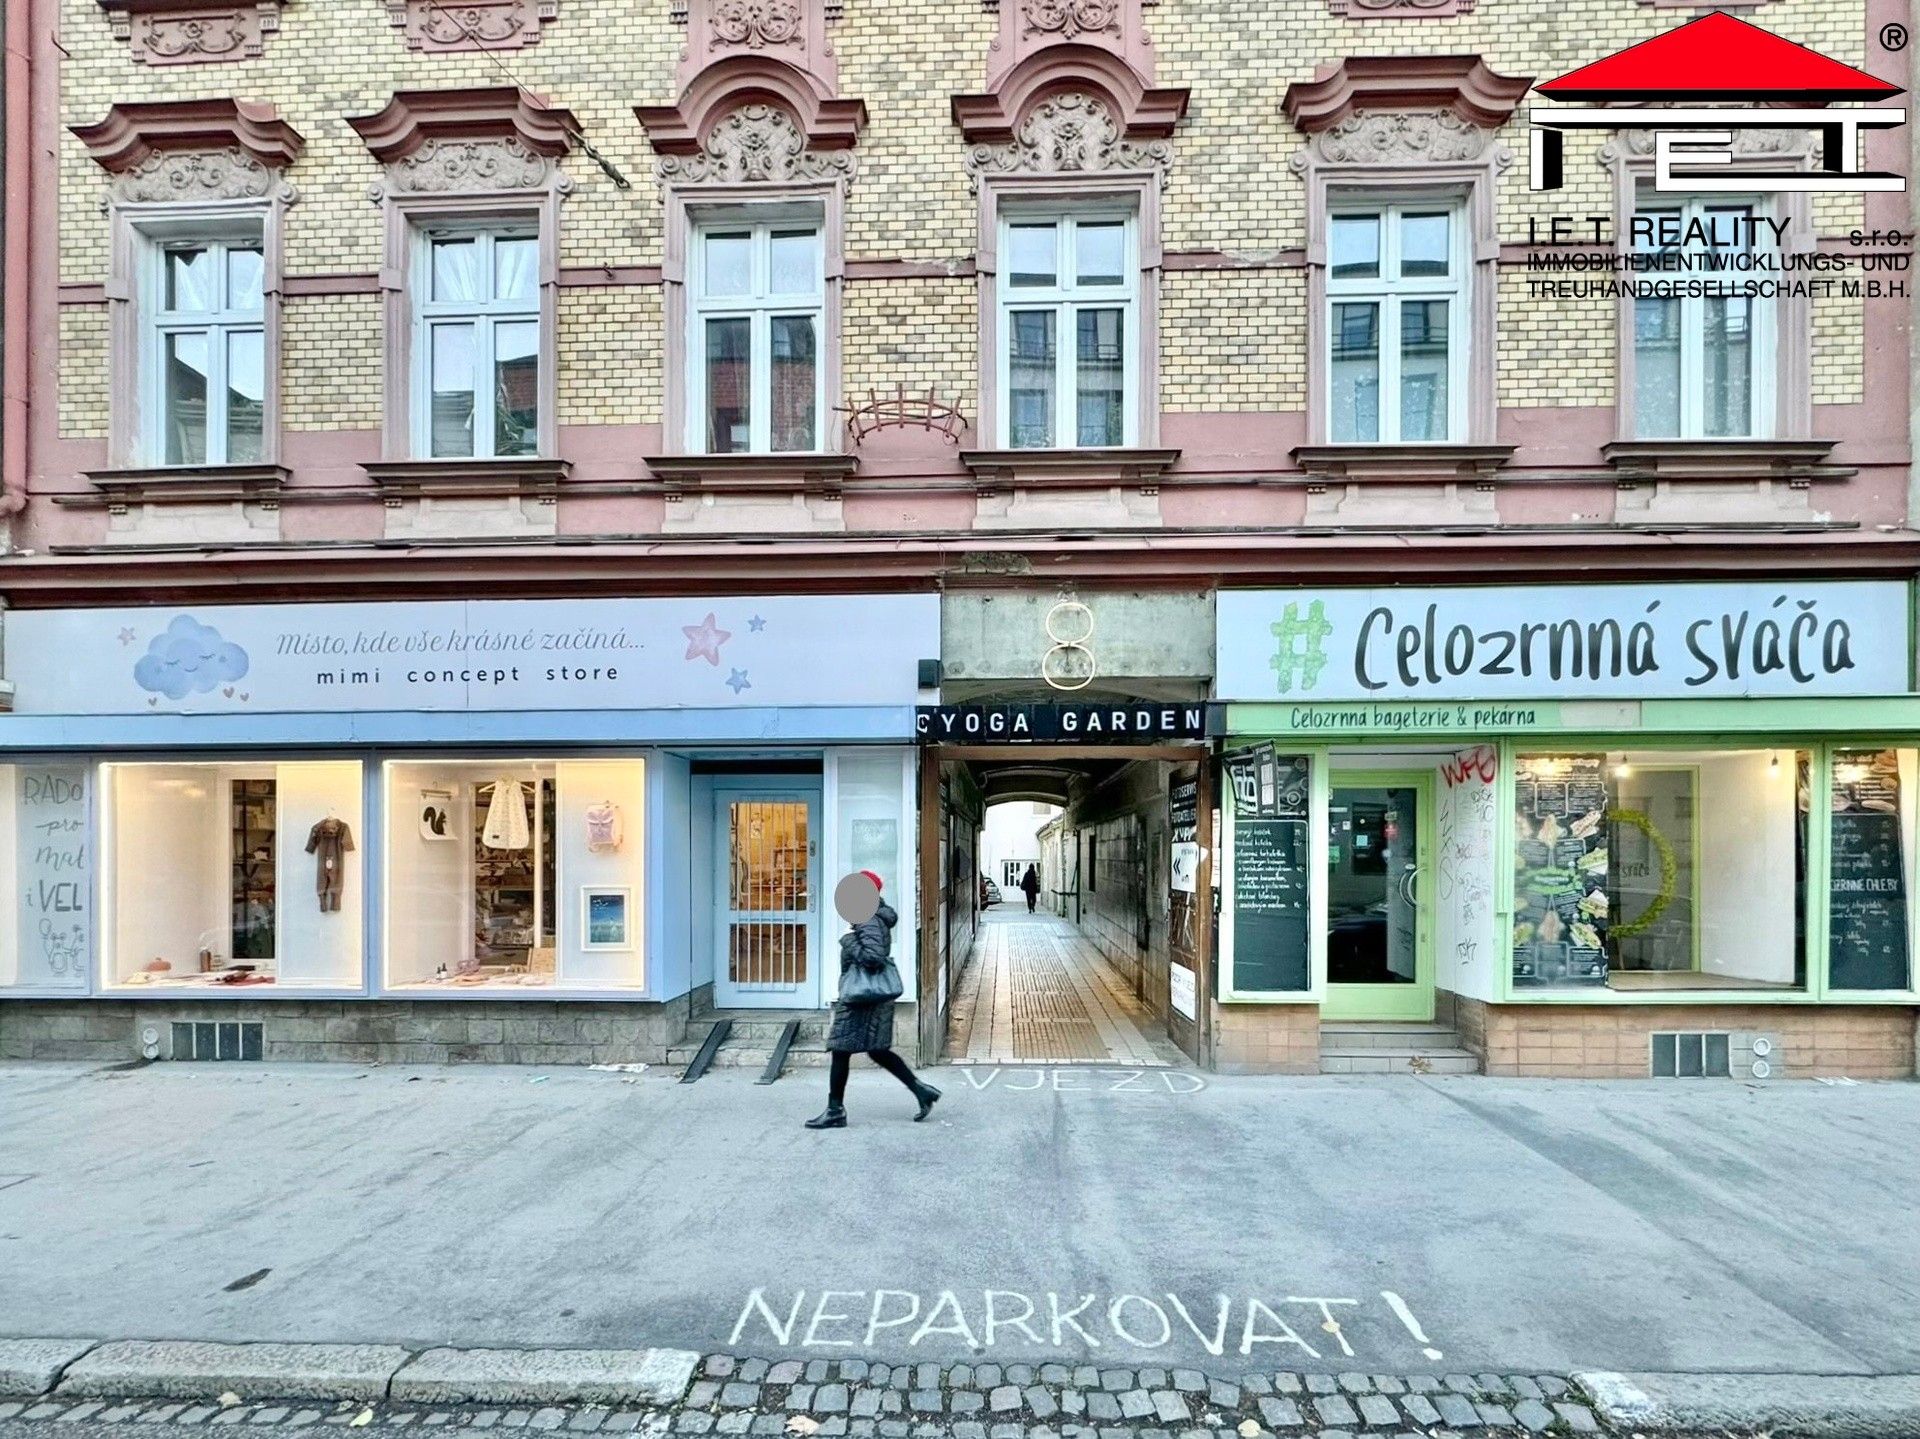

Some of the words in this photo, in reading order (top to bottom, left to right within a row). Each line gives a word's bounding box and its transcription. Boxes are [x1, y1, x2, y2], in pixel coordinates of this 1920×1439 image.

[354, 630, 399, 653] kde
[404, 630, 443, 652] vše
[447, 628, 534, 652] krásné
[1354, 599, 1661, 690] Celozrnná
[1684, 594, 1856, 686] sváča
[316, 667, 381, 685] mimi
[407, 666, 520, 686] concept
[546, 664, 618, 681] store
[1062, 709, 1201, 732] GARDEN
[1290, 706, 1368, 729] Celozrnná
[1373, 704, 1450, 731] bageterie
[1456, 705, 1467, 726] &
[1474, 703, 1536, 730] pekárna
[961, 1067, 1208, 1094] VJEZD
